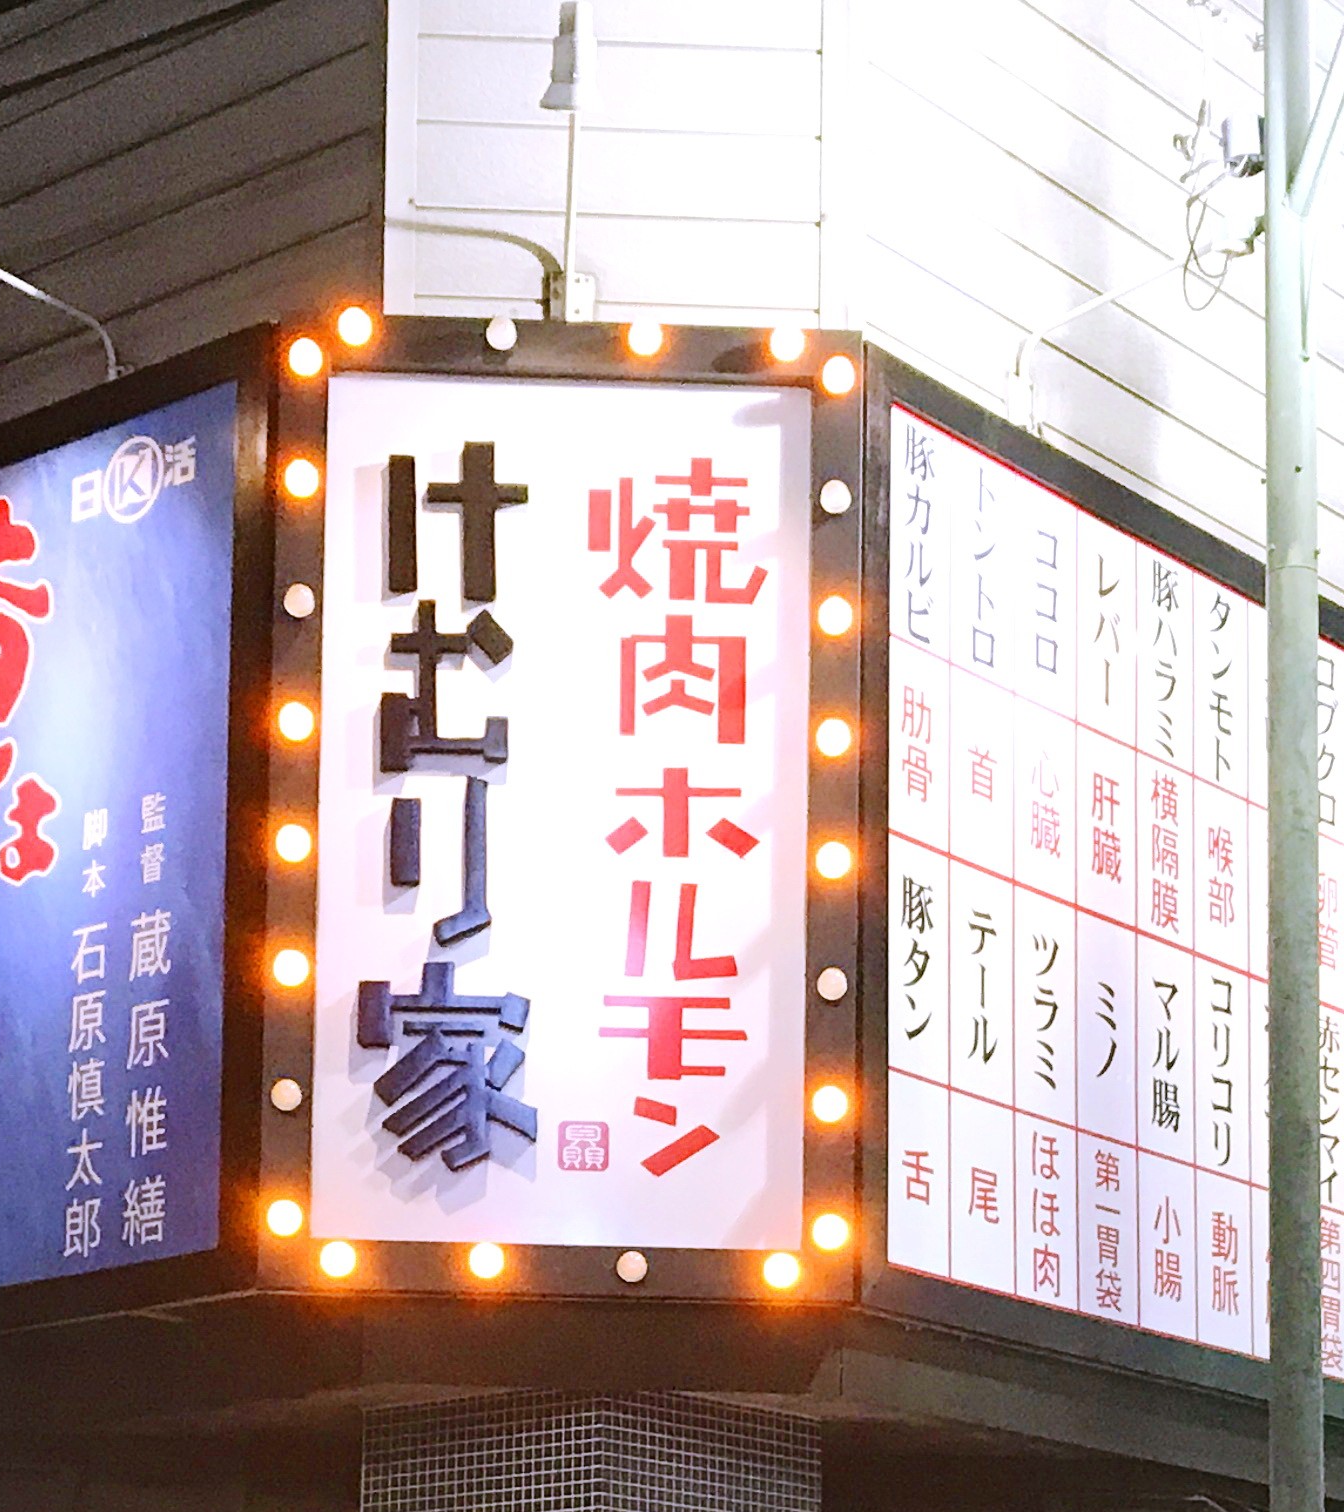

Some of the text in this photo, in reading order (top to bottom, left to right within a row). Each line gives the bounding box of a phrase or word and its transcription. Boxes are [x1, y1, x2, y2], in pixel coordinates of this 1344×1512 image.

[904, 423, 935, 643] 豚カルビ
[971, 465, 997, 669] トントロ
[1036, 529, 1059, 675] ココロ
[1093, 553, 1120, 707] レバー
[1151, 559, 1180, 760] 豚ハラミ
[1208, 592, 1234, 784] タンモト
[356, 440, 539, 1174] けむり家
[586, 457, 768, 1178] 焼肉ホルモン
[901, 685, 933, 804] 肋骨
[968, 745, 998, 803] 首
[1032, 750, 1062, 860] 心臓
[1091, 772, 1122, 885] 肝臓
[1151, 775, 1180, 935] 横隔膜
[1208, 825, 1235, 928] 喉部
[62, 809, 108, 1258] 脚本 石原慎太郎
[120, 793, 173, 1243] 監督 蔵原惟繕
[901, 874, 934, 1041] 豚タン
[967, 907, 998, 1066] テール
[1032, 932, 1060, 1092] ツラミ
[1094, 981, 1119, 1080] ミノ
[1150, 976, 1181, 1134] マル腸
[1209, 975, 1235, 1168] コリコリ
[901, 1150, 935, 1206] 舌
[968, 1167, 1000, 1226] 尾
[1032, 1131, 1062, 1298] ほほ肉
[1094, 1149, 1123, 1313] 第一胃袋
[1153, 1196, 1183, 1303] 小腸
[1210, 1211, 1241, 1317] 動脈
